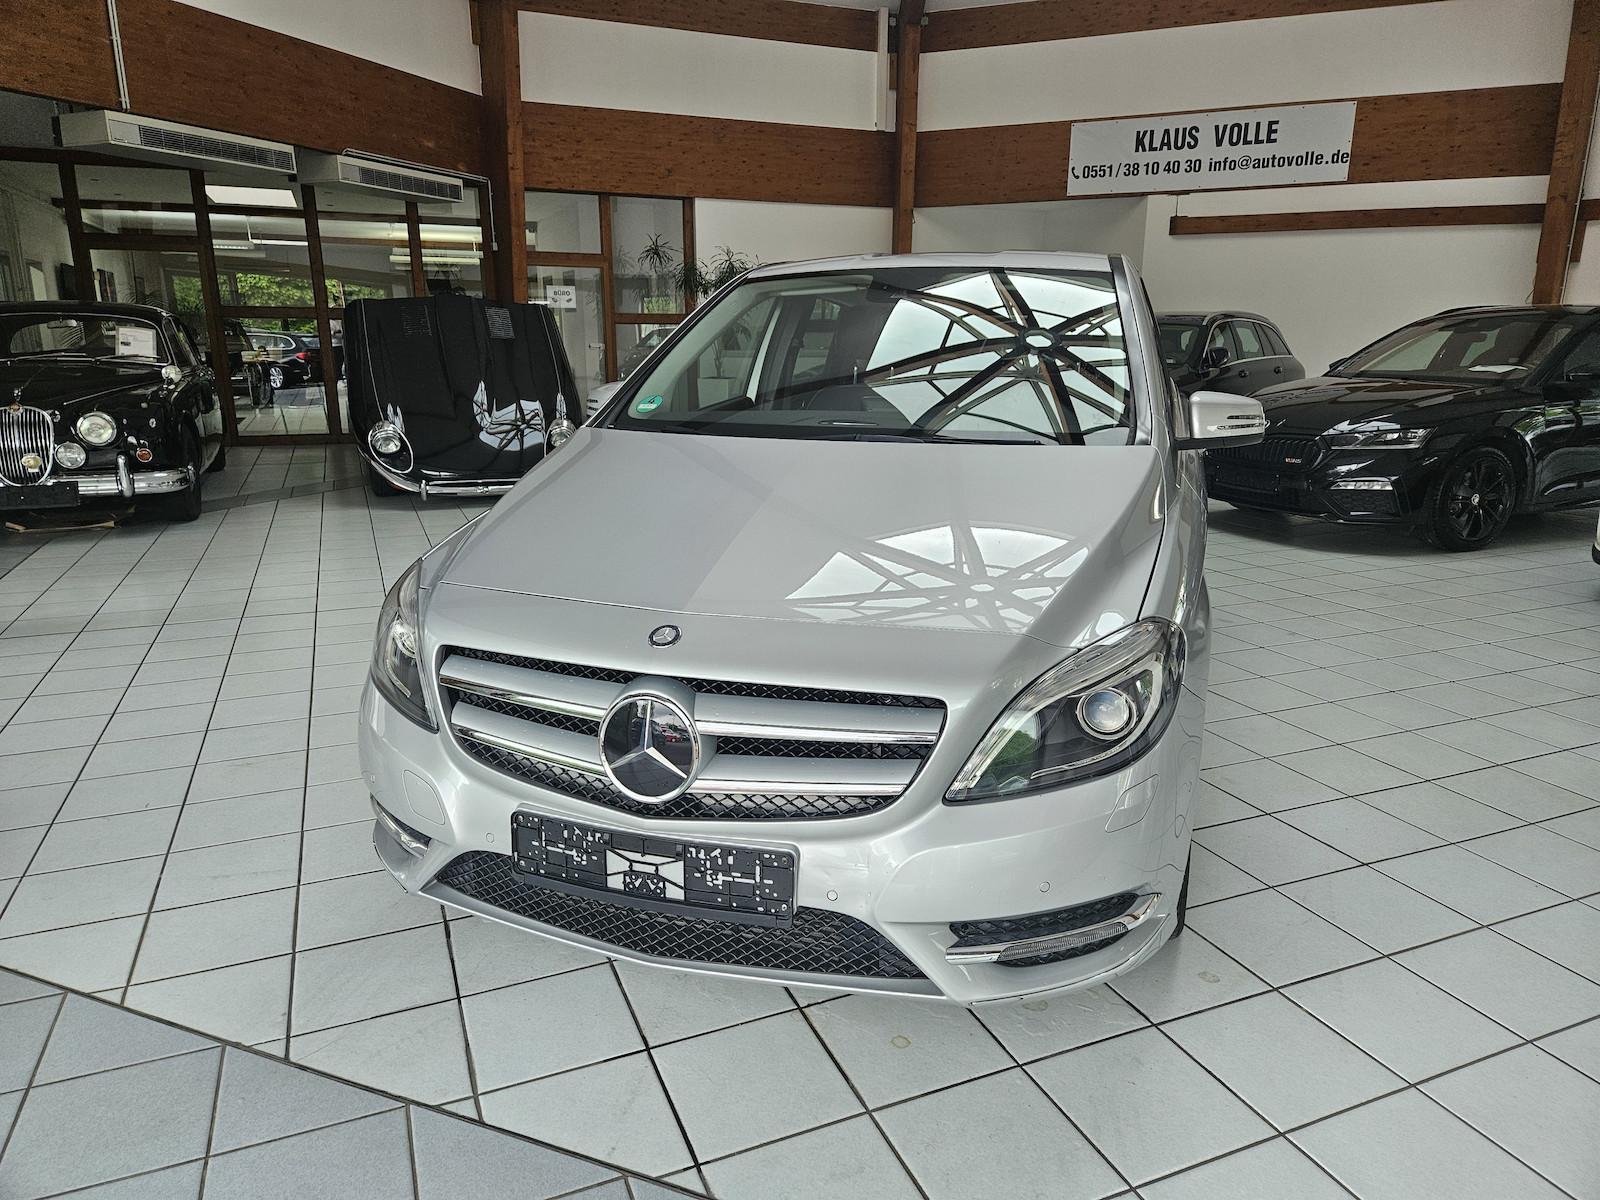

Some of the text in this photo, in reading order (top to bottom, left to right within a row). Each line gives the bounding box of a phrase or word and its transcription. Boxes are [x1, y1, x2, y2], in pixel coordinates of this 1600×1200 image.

[1134, 120, 1280, 153] KLAUS VOLLE
[1143, 160, 1160, 176] 10
[1163, 159, 1180, 175] 40
[1184, 158, 1202, 174] 30
[1208, 149, 1350, 173] info@autovolle.de
